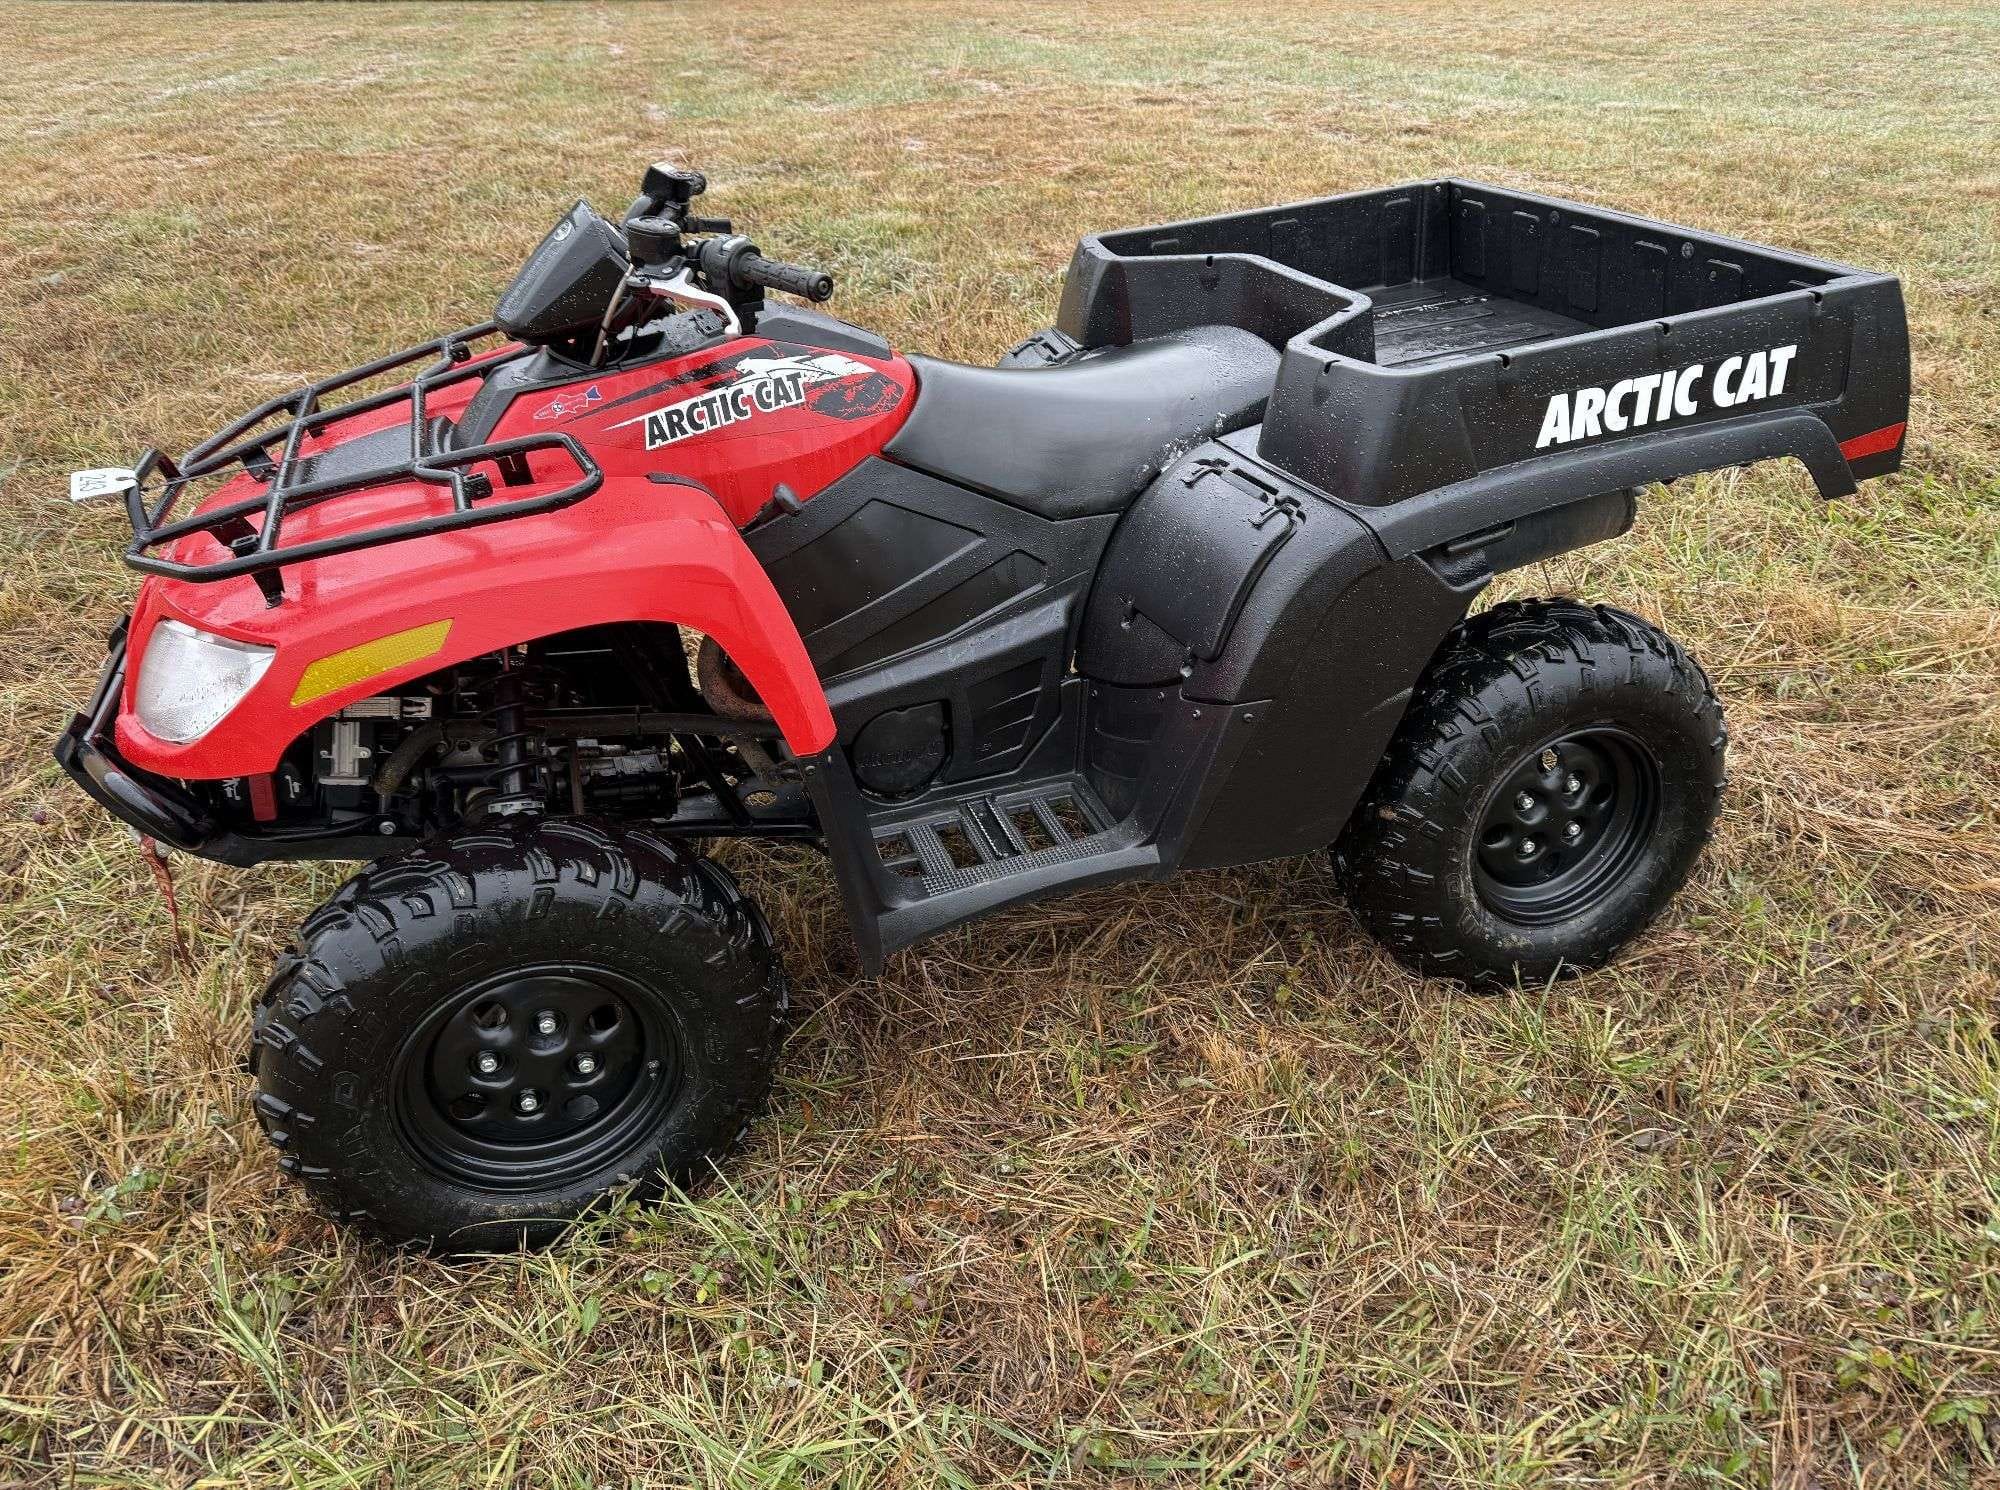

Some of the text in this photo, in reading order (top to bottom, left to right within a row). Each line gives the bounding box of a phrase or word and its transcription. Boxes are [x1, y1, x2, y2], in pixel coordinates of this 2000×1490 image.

[647, 372, 804, 447] ARCTIC CAT
[1536, 345, 1797, 448] ARCTIC CAT
